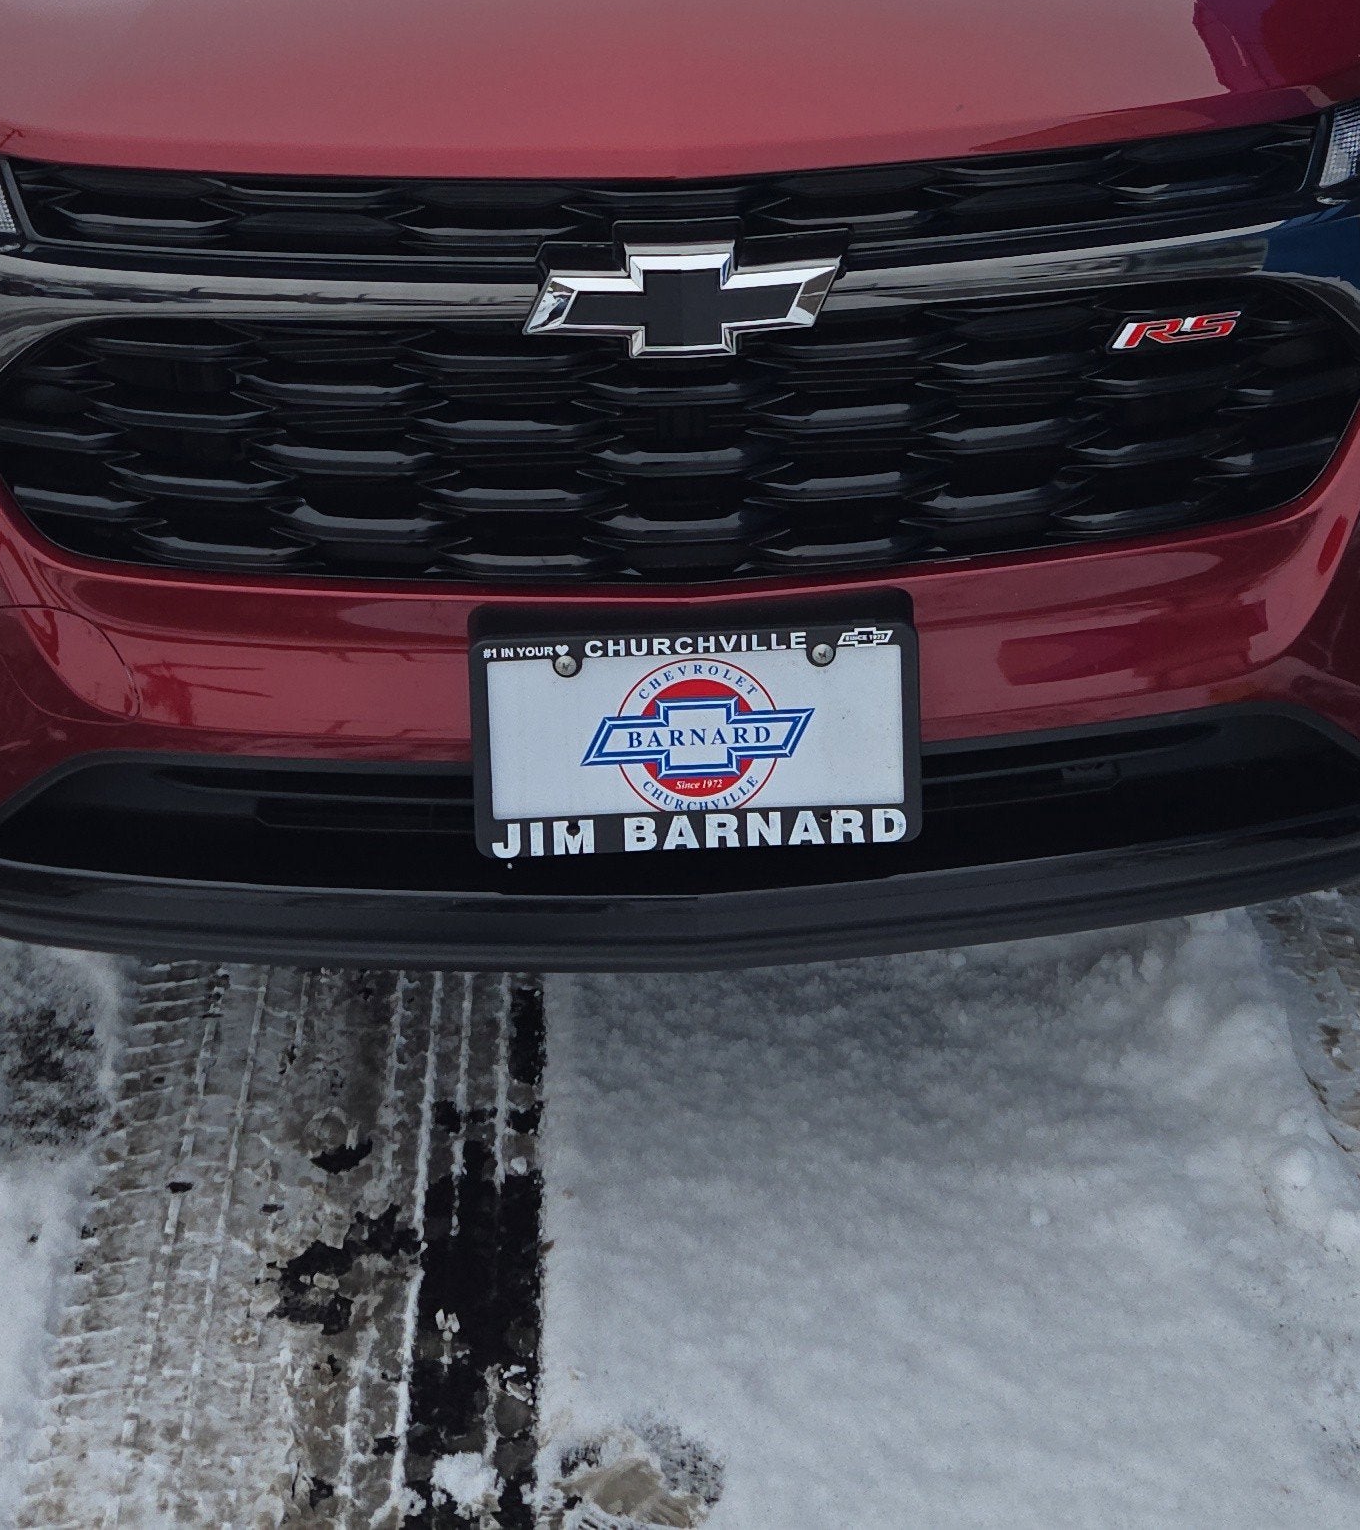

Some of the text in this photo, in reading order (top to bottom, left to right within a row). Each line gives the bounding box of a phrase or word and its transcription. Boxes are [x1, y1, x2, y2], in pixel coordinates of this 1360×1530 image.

[1112, 311, 1241, 349] RS
[501, 647, 514, 658] IN
[516, 646, 554, 657] YOUR
[584, 631, 807, 658] CHURCHVILLE
[638, 664, 758, 700] CHEVROLET
[627, 726, 771, 748] BARNARD
[642, 776, 759, 811] CHURCHVILLE
[675, 780, 701, 789] Since
[492, 808, 908, 859] JIM BARNARD
